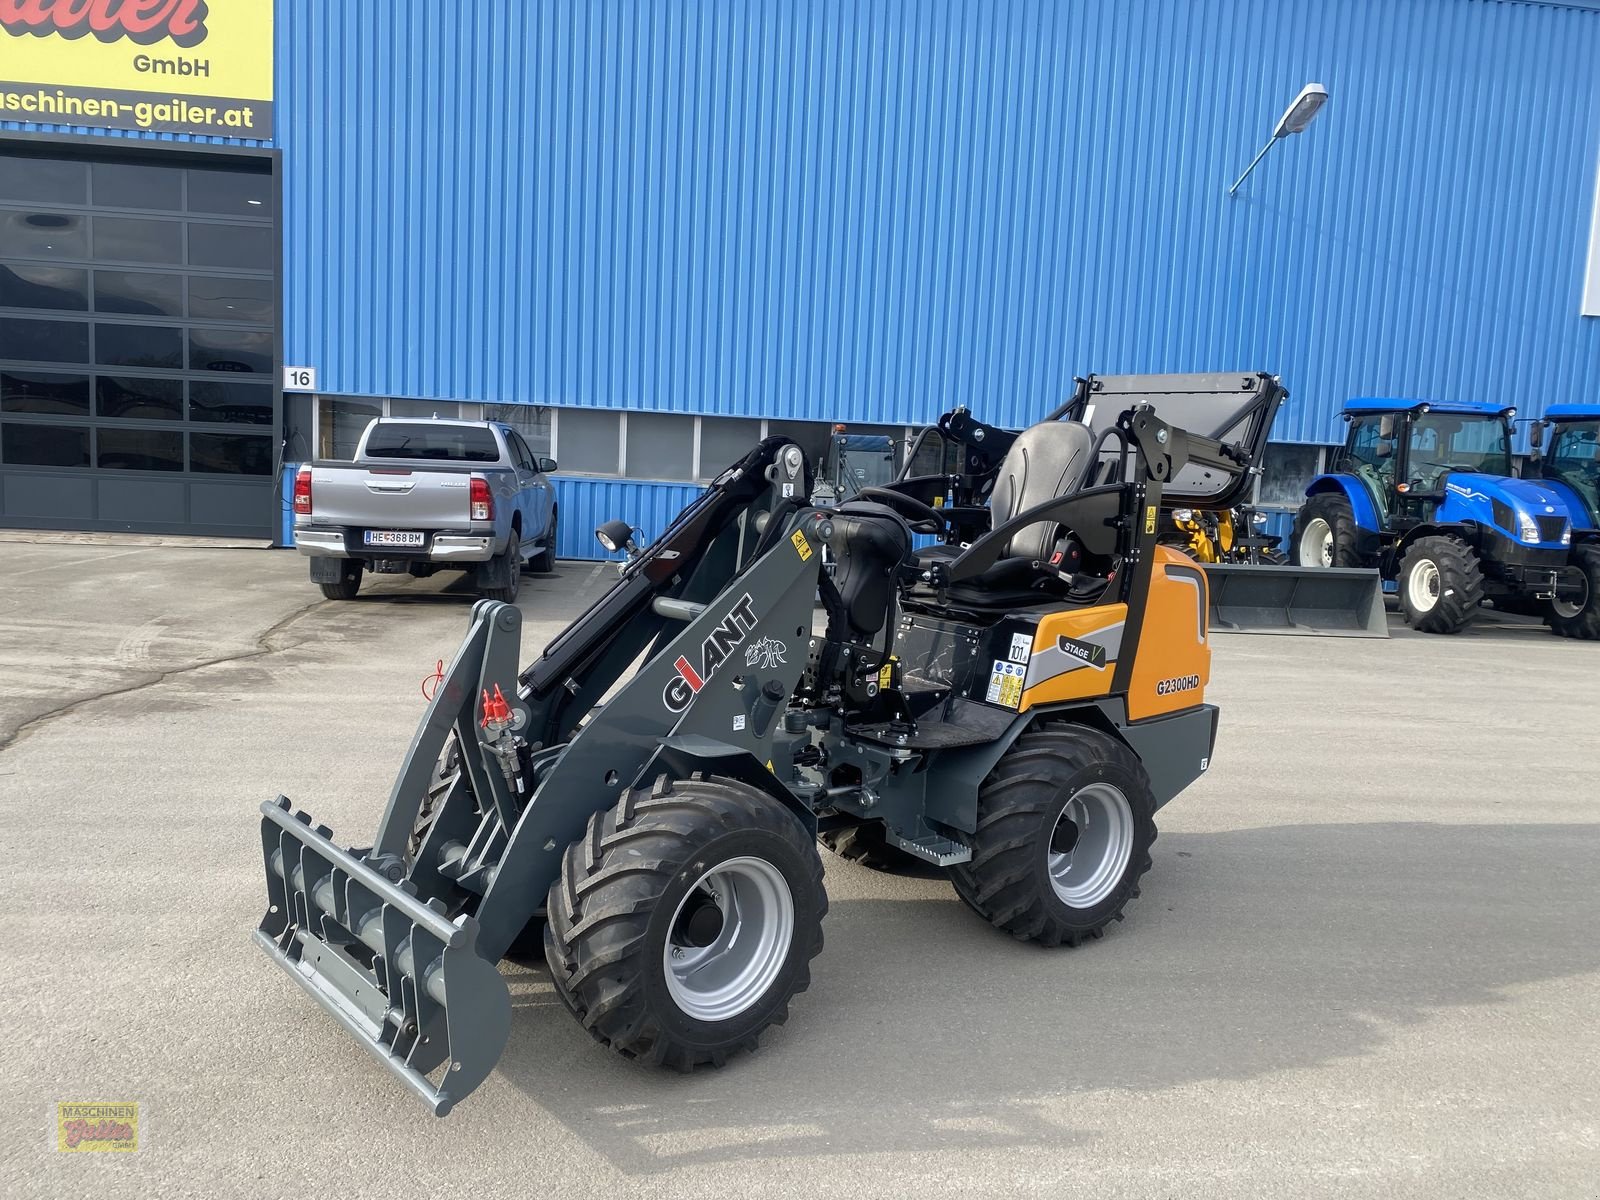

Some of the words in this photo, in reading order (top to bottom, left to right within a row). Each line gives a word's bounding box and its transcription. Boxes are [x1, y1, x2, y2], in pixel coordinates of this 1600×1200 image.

[133, 54, 210, 77] GmbH
[0, 90, 254, 128] schinen-gailer.at
[290, 371, 310, 386] 16
[372, 532, 384, 542] HE
[390, 533, 408, 543] 368
[662, 592, 759, 713] GIANT
[1010, 645, 1024, 661] 101
[1064, 642, 1090, 659] STAGE
[1156, 674, 1201, 696] G2300HD
